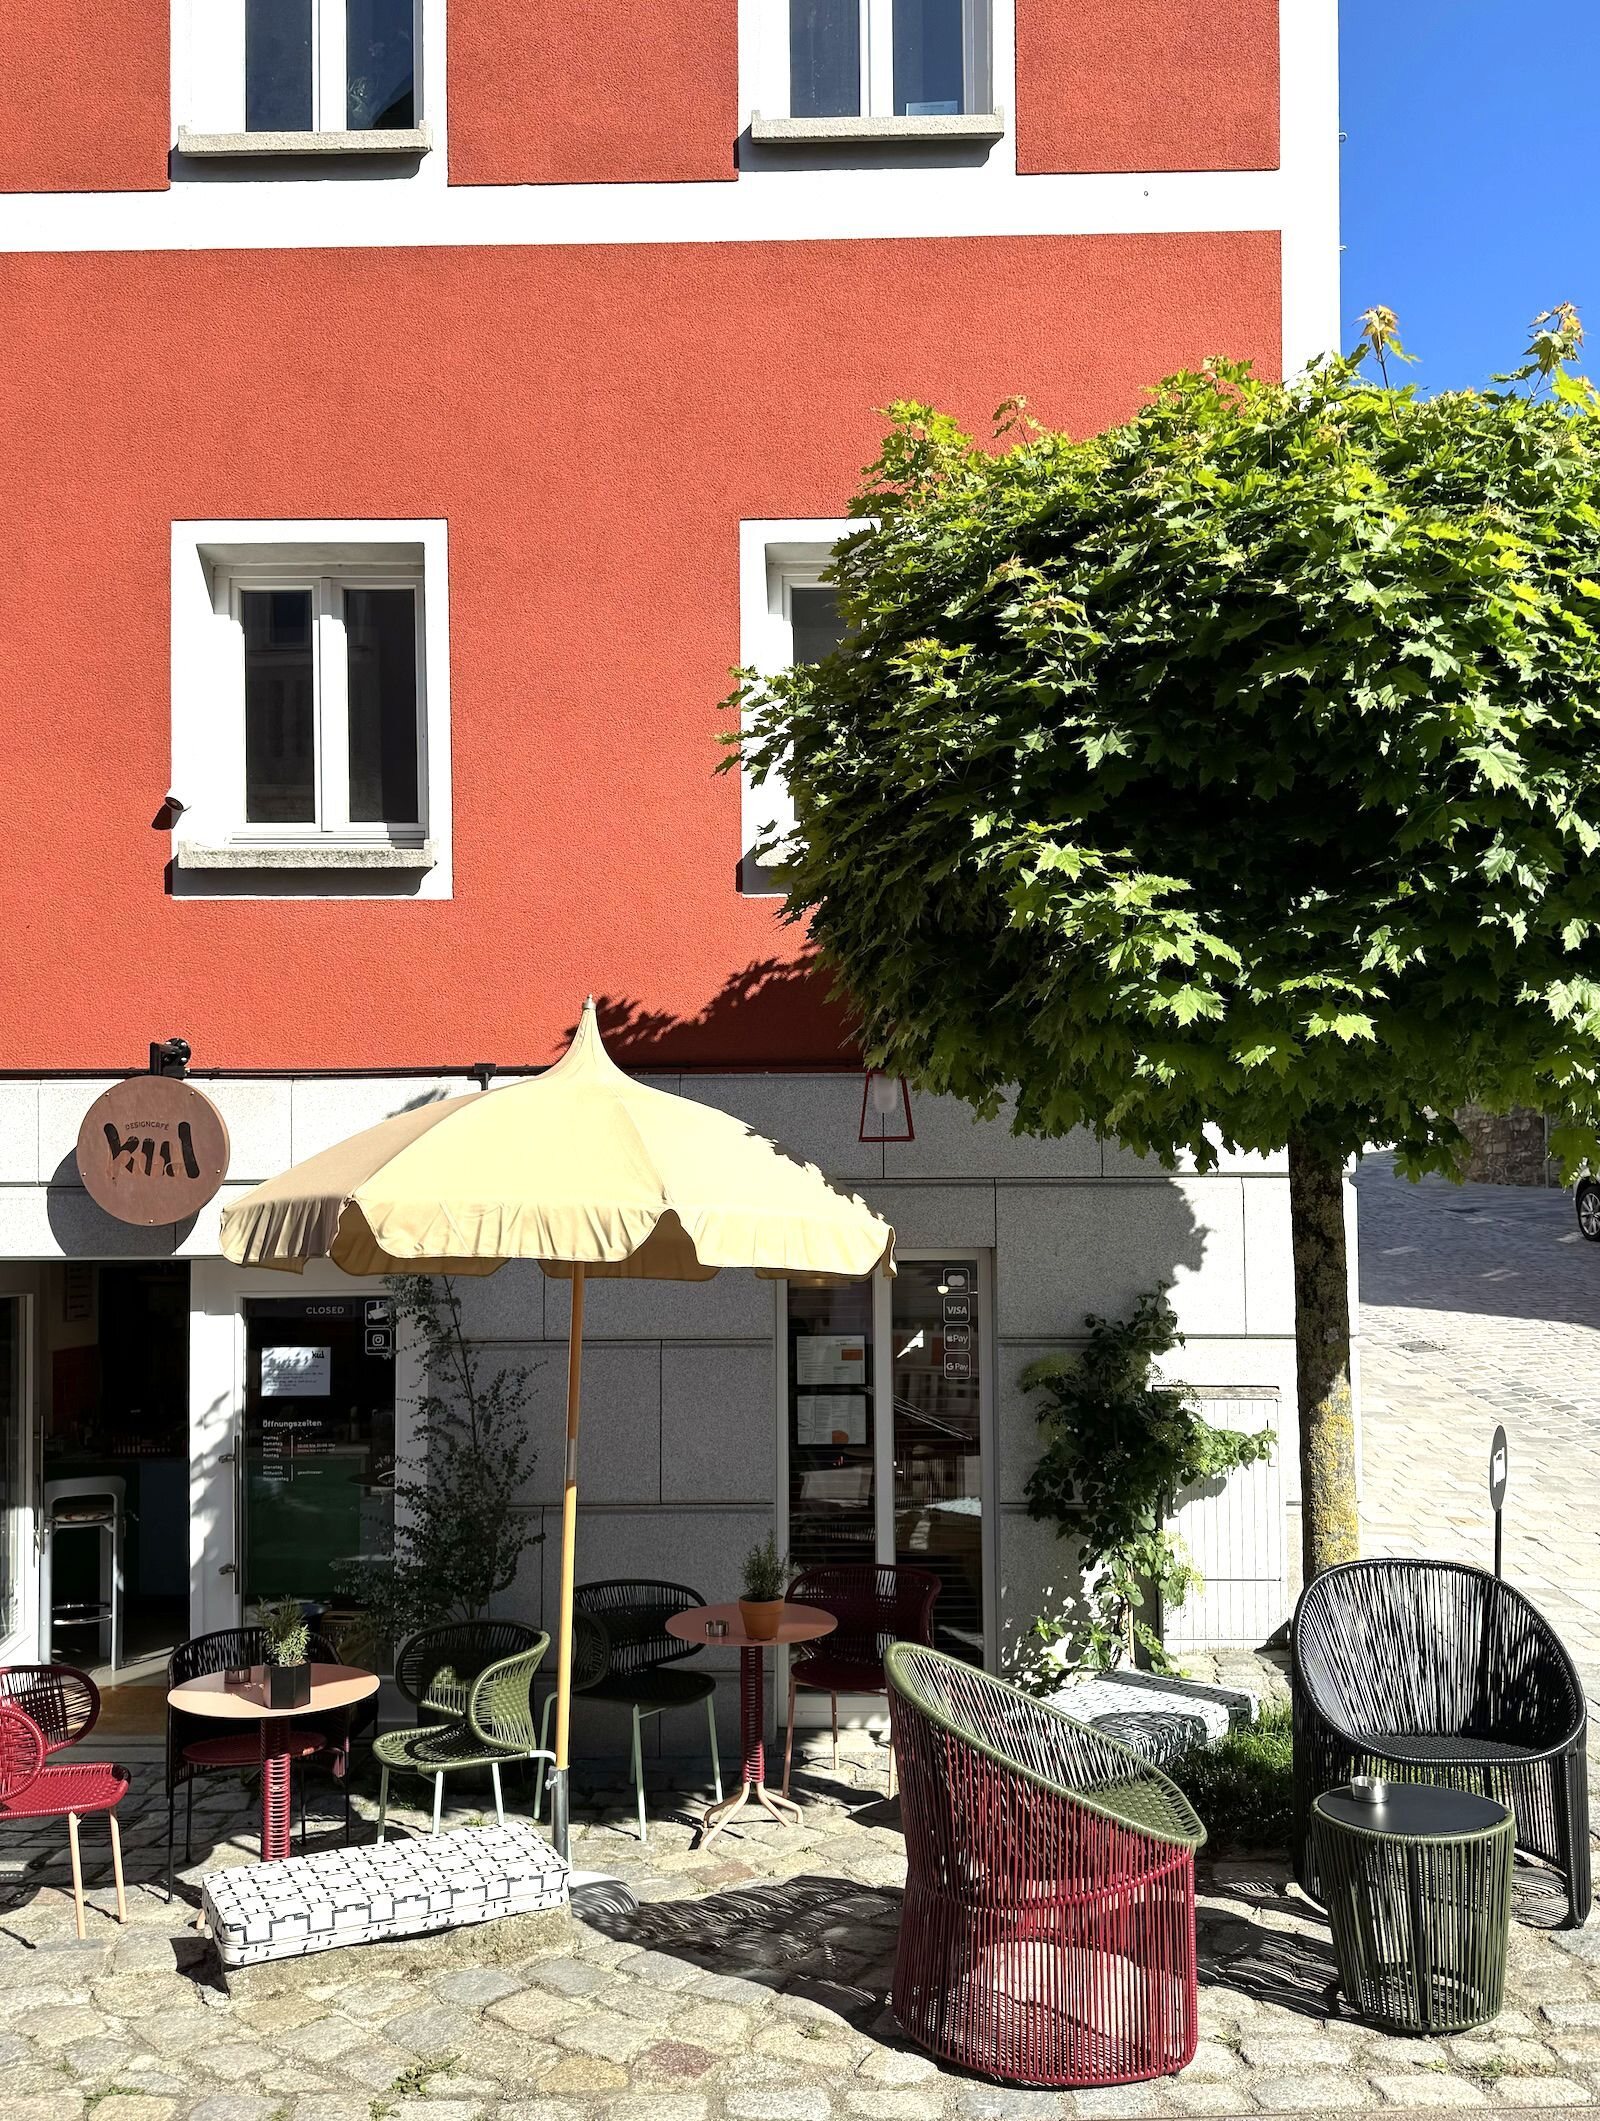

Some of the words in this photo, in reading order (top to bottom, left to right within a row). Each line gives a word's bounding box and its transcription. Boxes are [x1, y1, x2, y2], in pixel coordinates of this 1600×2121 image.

[305, 1306, 345, 1315] CLOSED
[946, 1306, 968, 1315] VISA
[953, 1334, 968, 1344] Pay
[954, 1362, 968, 1372] Pay
[262, 1418, 323, 1430] Öffnungszeiten
